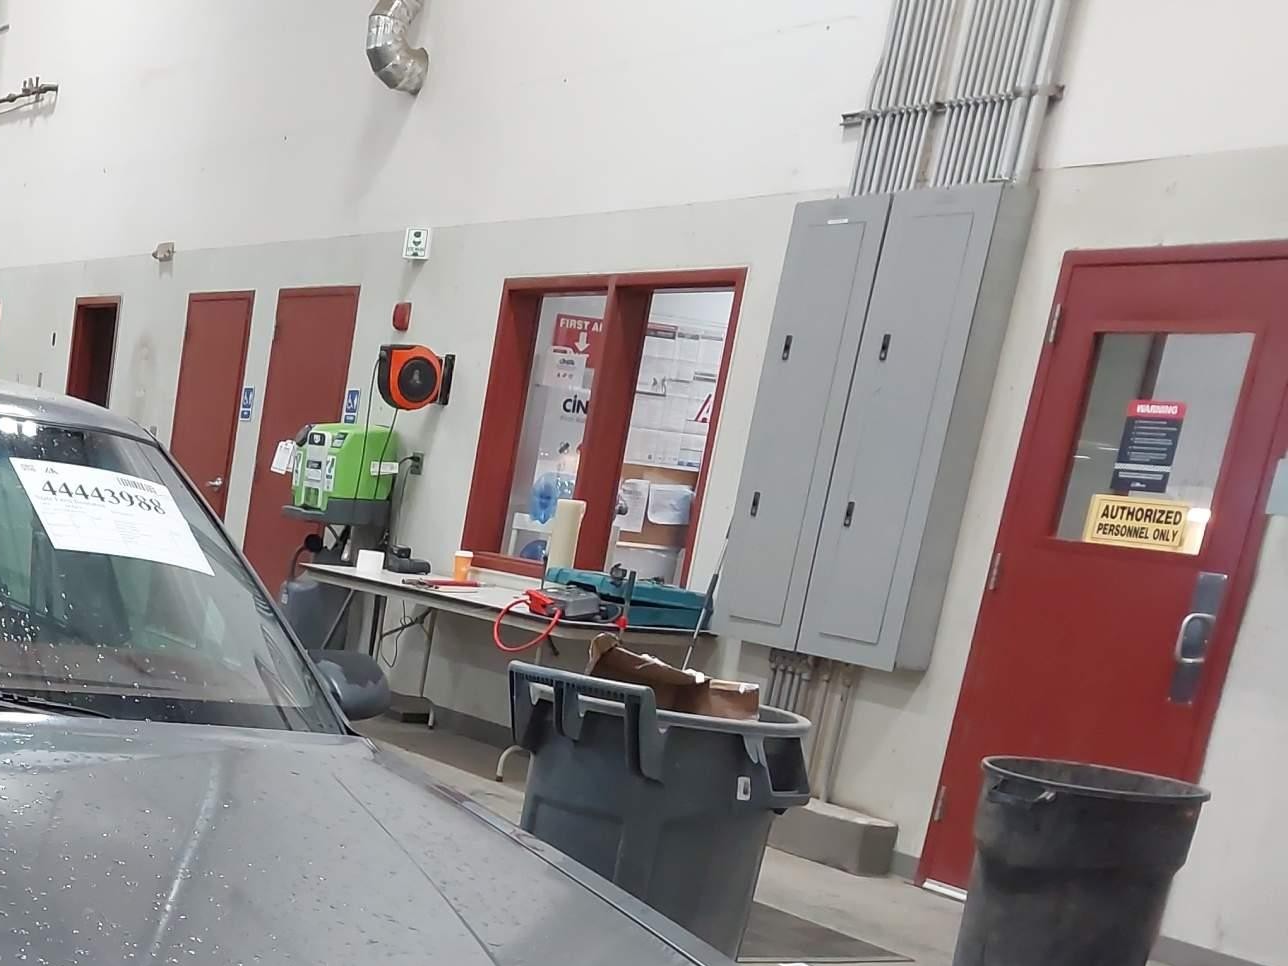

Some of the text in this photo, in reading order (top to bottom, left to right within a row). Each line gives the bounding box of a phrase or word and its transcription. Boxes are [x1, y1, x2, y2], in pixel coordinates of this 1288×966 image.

[559, 318, 603, 333] FIRST AI
[1136, 404, 1179, 416] WARNING
[42, 480, 167, 515] 44443988
[1101, 504, 1183, 526] AUTHORIZED
[1096, 522, 1179, 543] PERSONNEL ONLY
